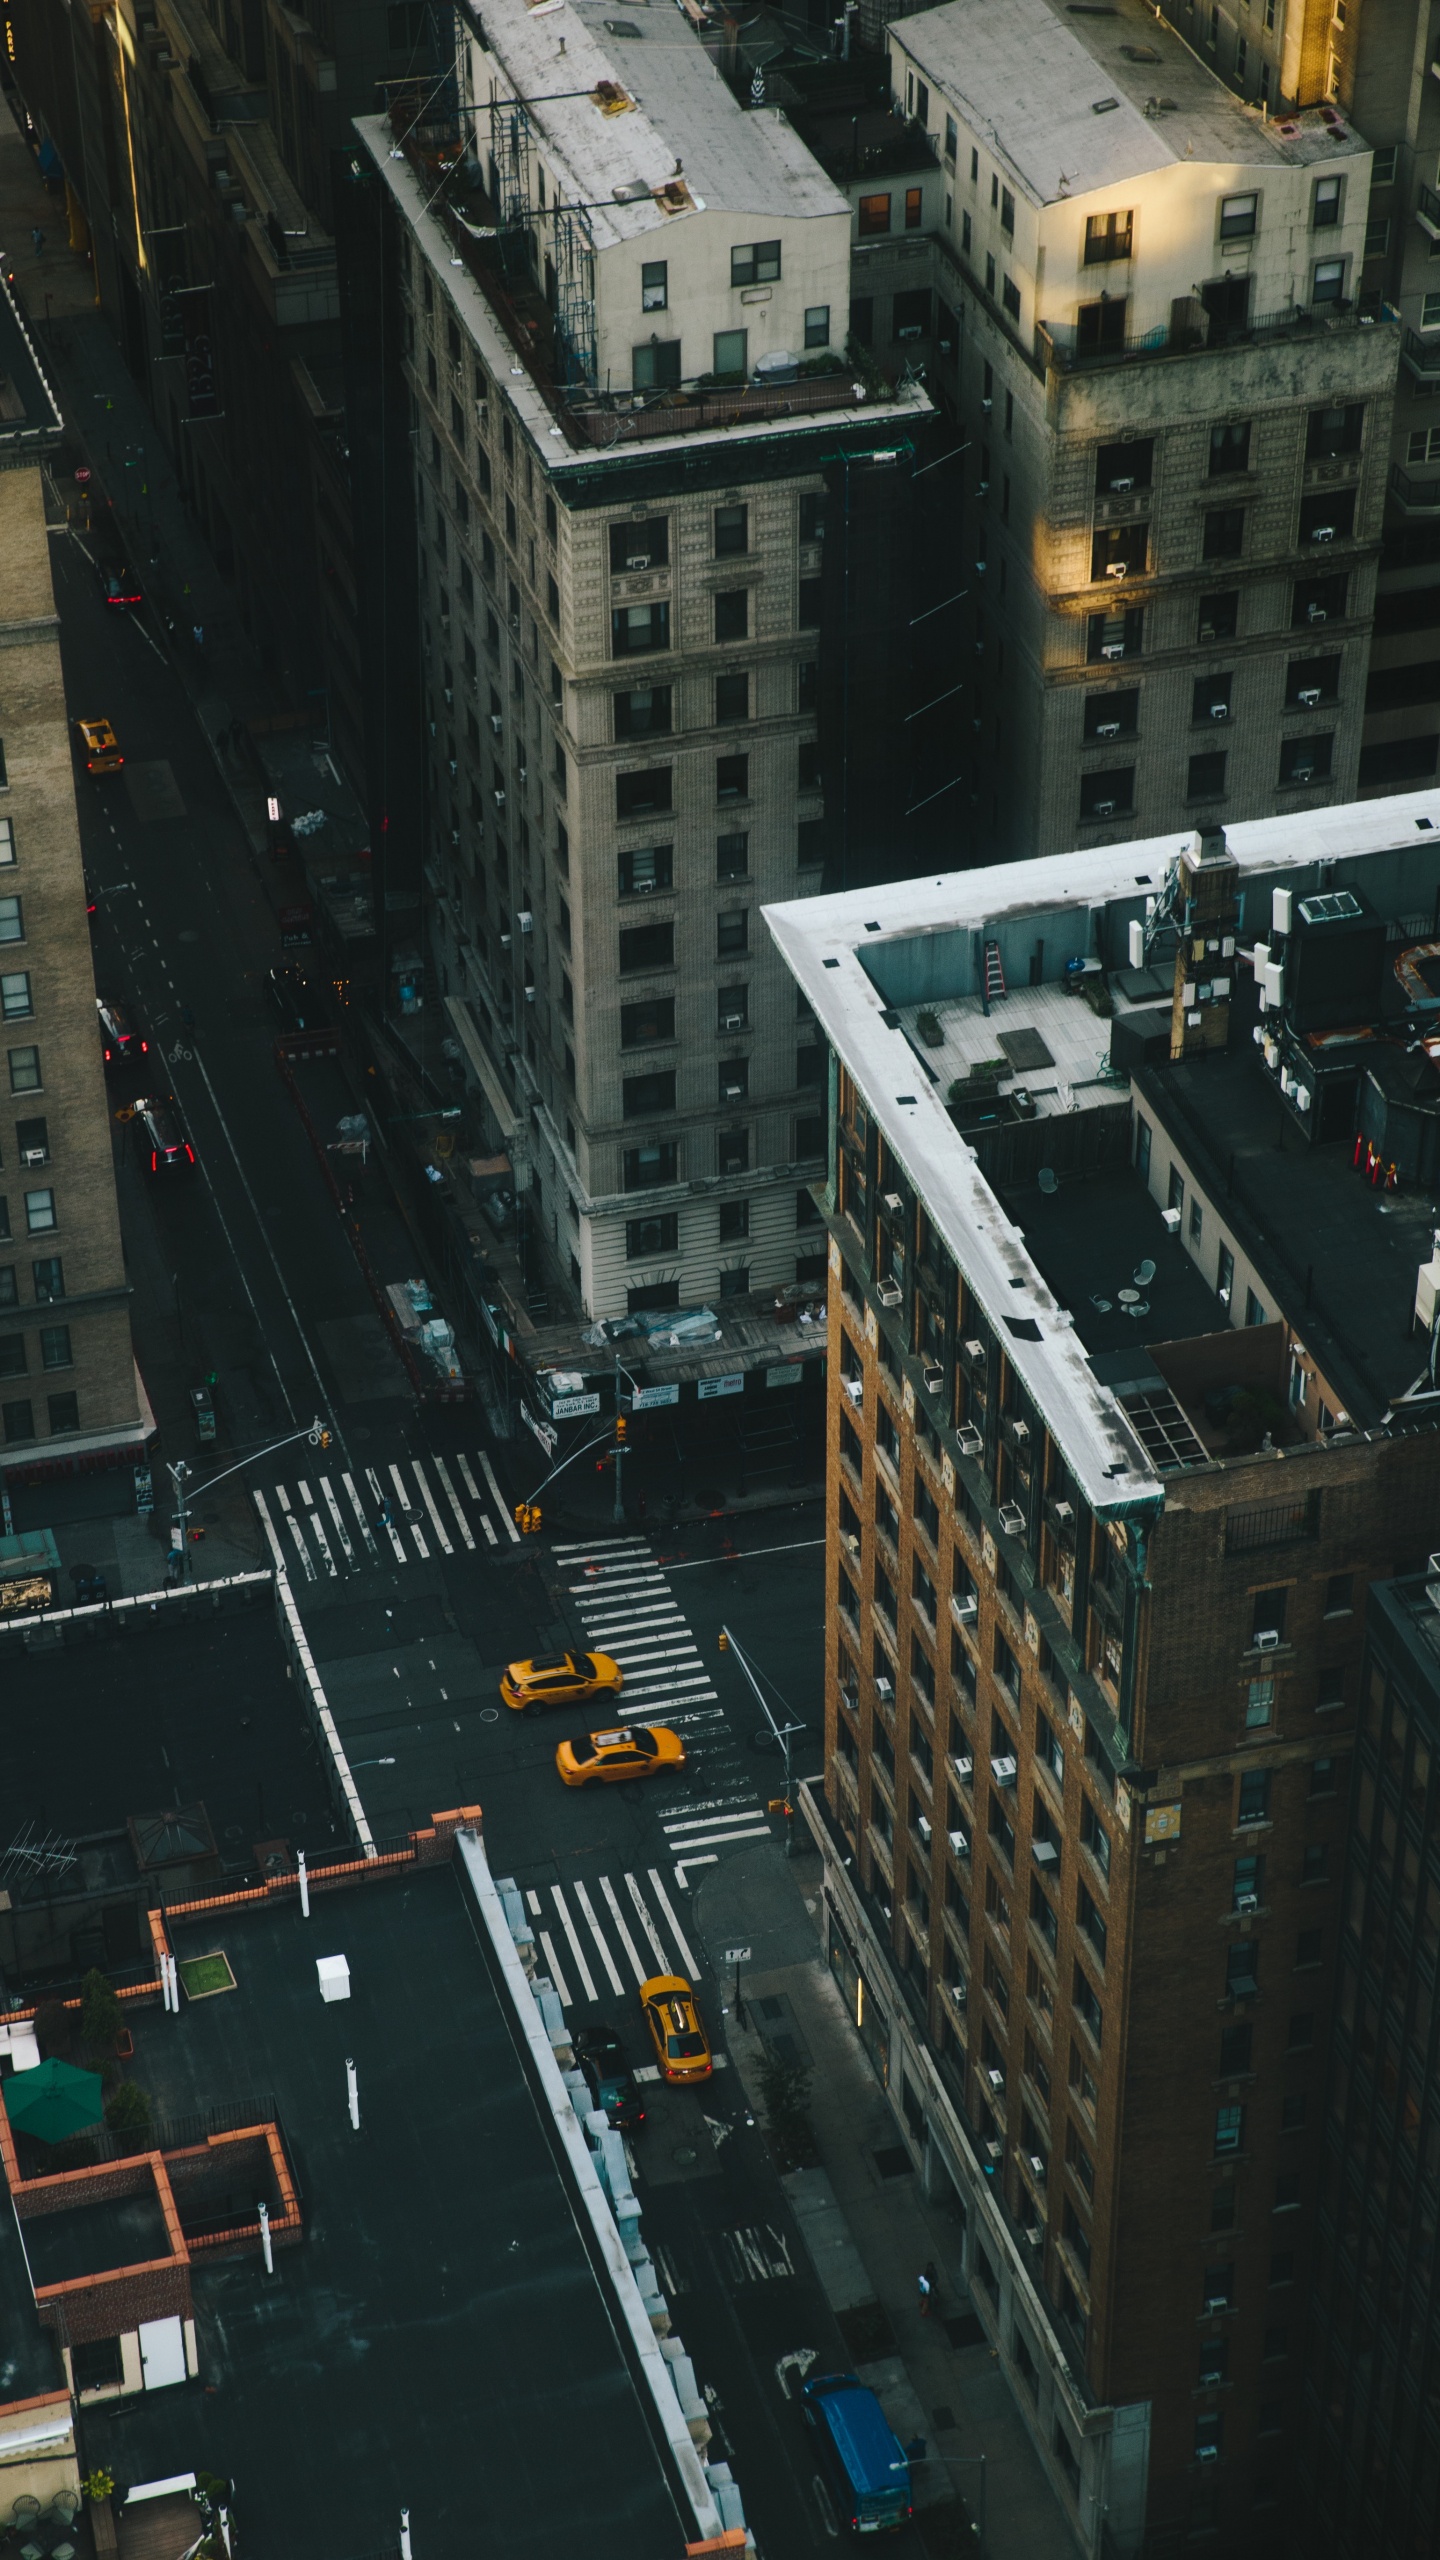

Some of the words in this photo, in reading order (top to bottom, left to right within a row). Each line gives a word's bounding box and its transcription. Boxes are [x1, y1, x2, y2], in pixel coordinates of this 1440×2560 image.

[5, 20, 15, 53] PARK
[185, 334, 215, 402] 1325
[76, 470, 90, 478] STOP
[555, 1404, 583, 1415] JANBAR
[583, 1401, 598, 1410] INC.
[722, 2224, 795, 2284] ONLY
